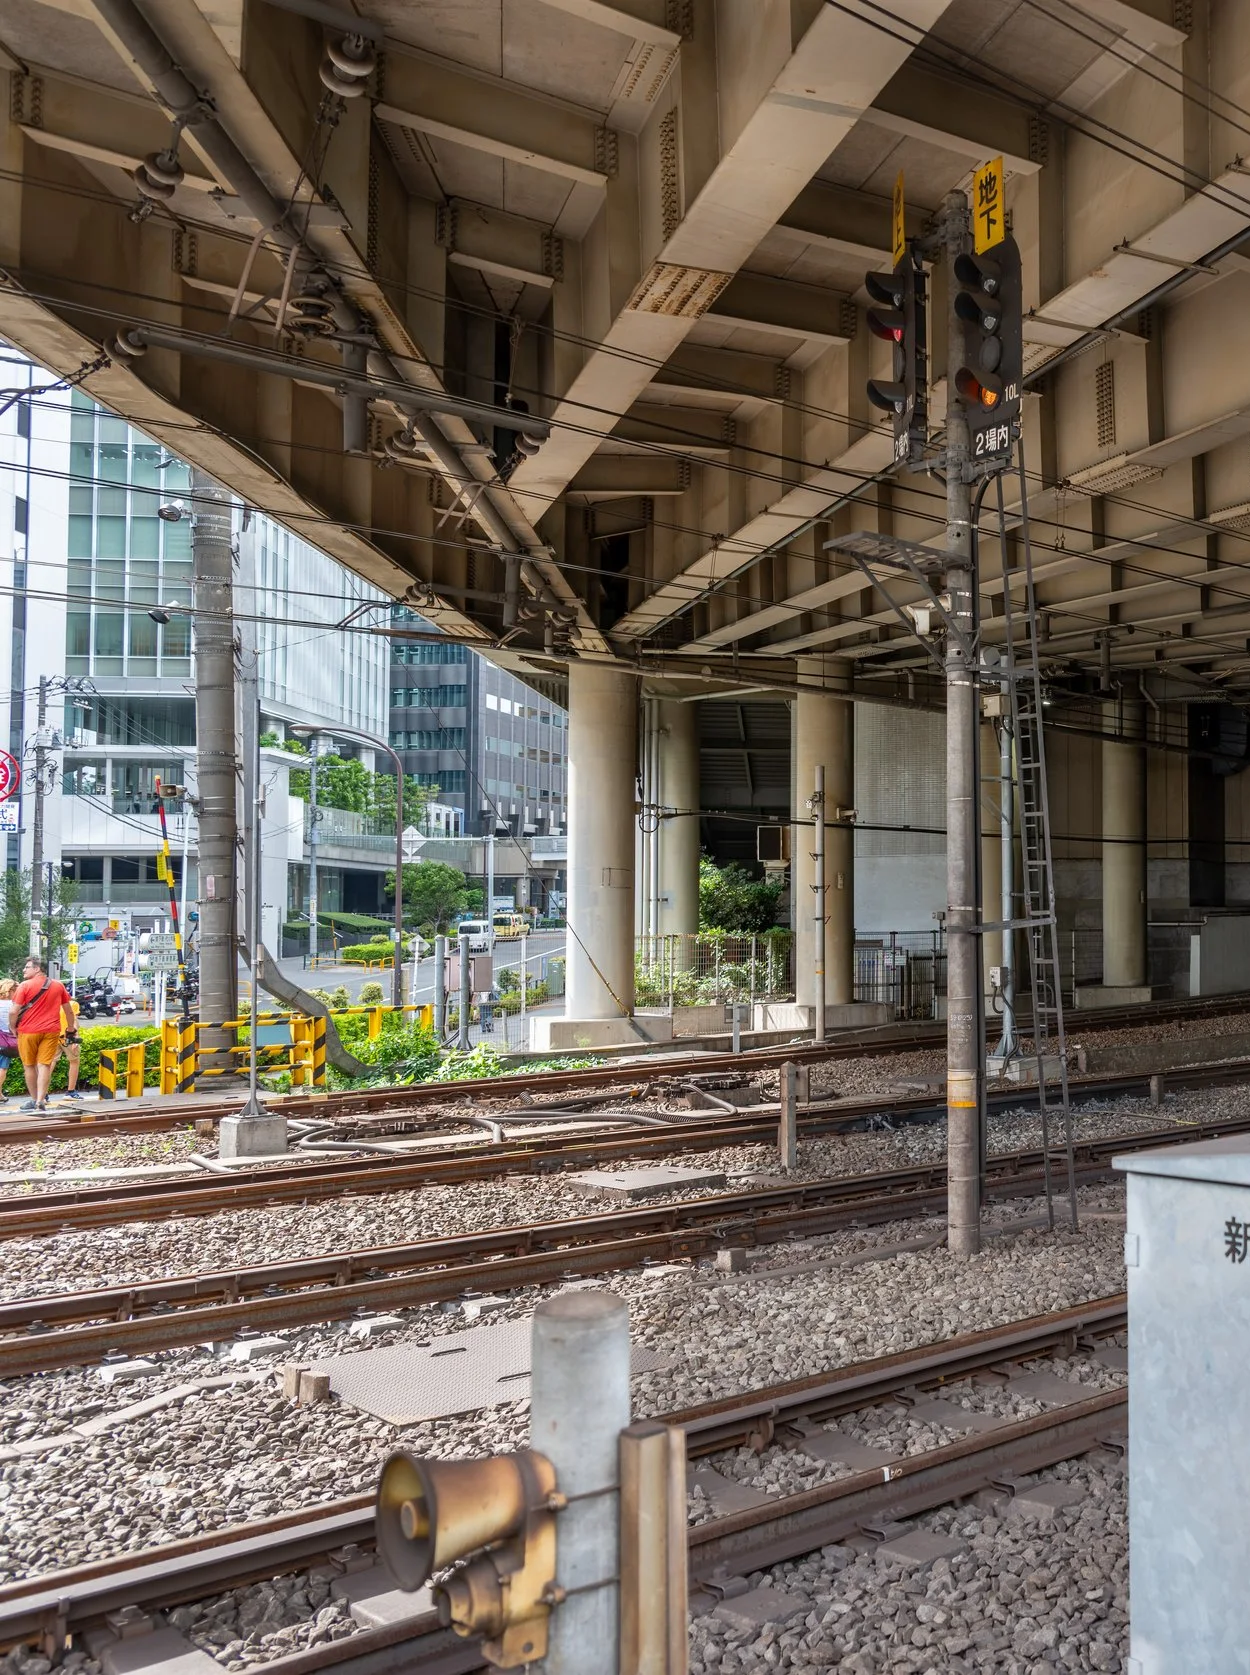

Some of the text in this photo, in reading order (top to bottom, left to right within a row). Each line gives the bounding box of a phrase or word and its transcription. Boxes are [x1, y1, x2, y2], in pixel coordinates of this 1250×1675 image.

[978, 171, 999, 240] 地下
[1004, 383, 1019, 401] 10L
[975, 424, 1009, 456] 2場内
